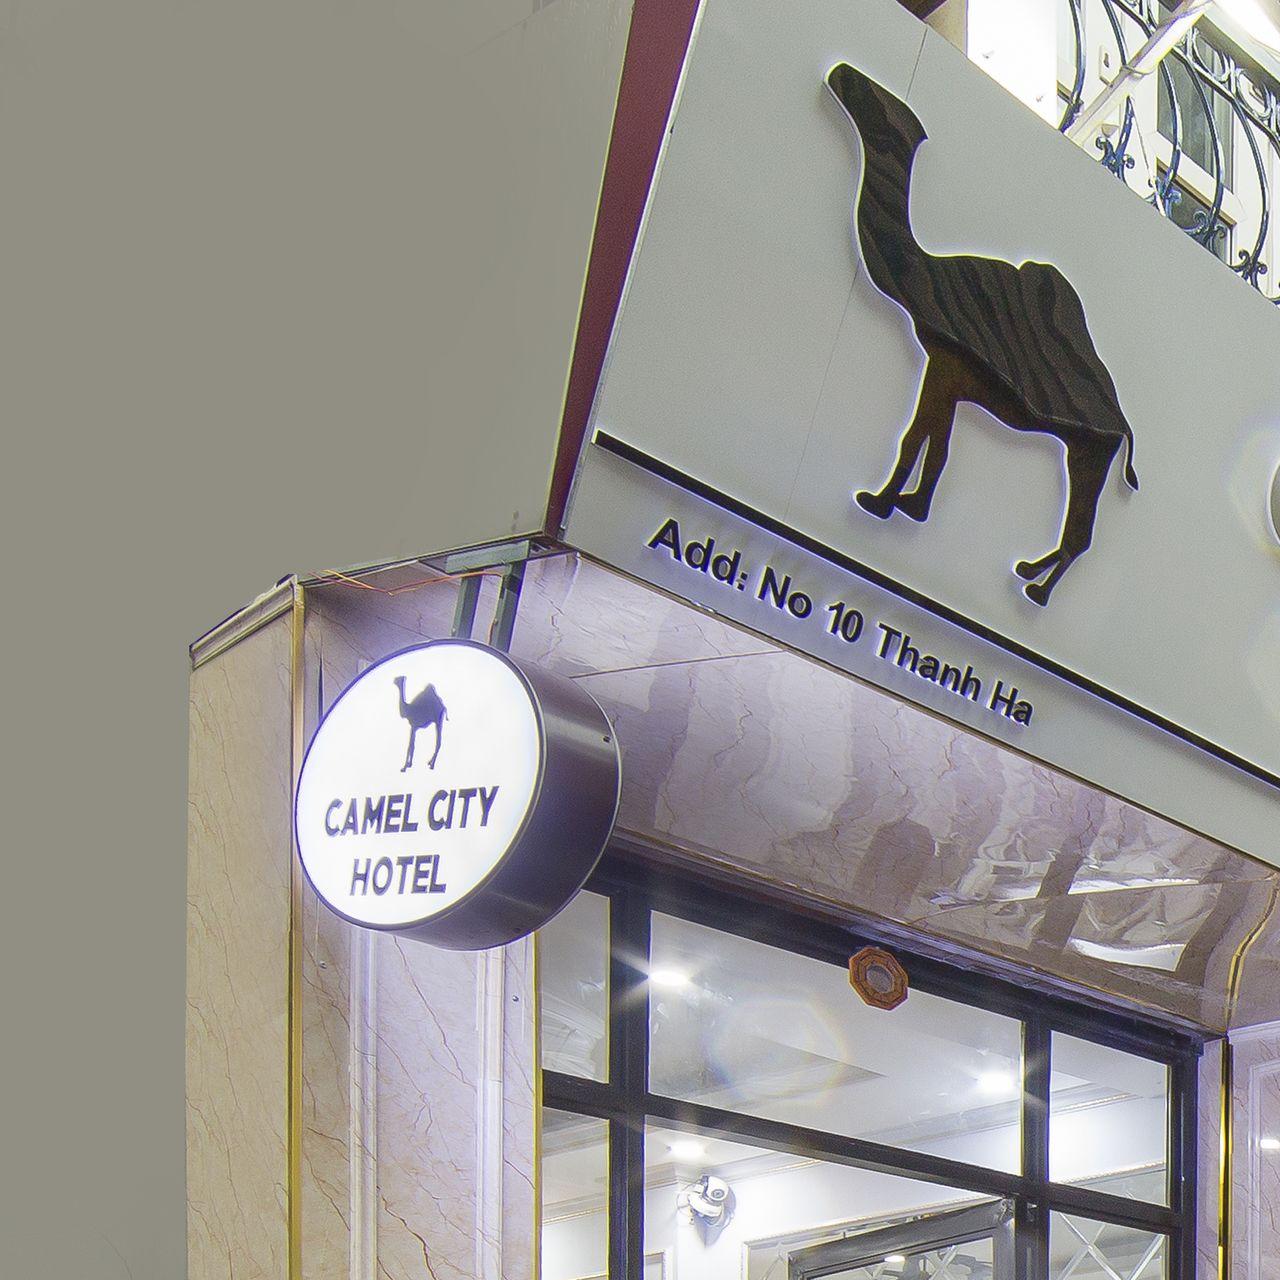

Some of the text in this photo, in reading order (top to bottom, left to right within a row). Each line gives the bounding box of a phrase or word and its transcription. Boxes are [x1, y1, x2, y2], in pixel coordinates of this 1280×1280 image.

[645, 518, 1034, 727] Add: No 10 Thanh Ha
[325, 786, 499, 836] CAMEL CITY
[350, 854, 447, 896] HOTEL
